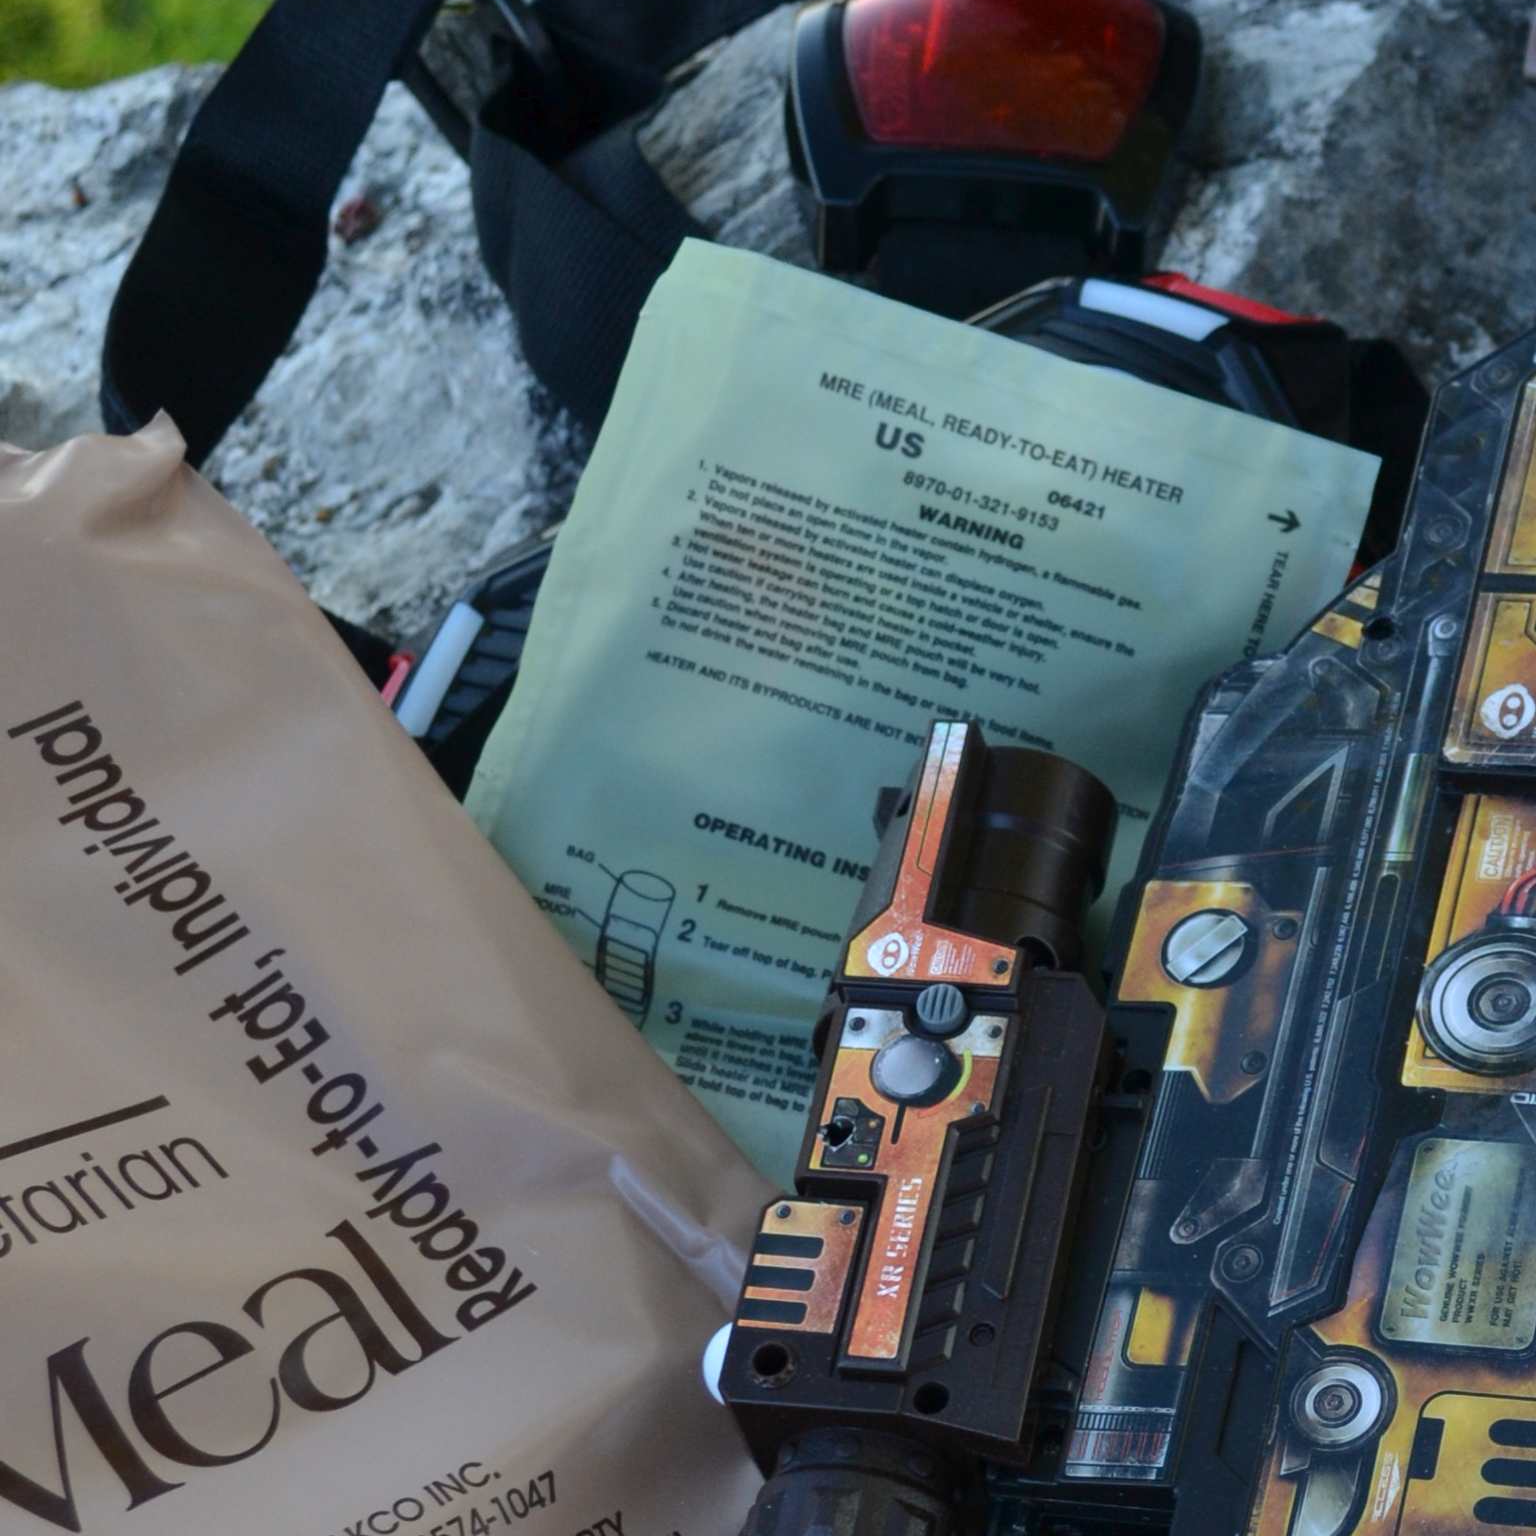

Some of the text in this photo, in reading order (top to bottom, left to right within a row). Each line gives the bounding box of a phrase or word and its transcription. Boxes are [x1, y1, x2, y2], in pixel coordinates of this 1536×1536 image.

[819, 372, 1184, 505] MRE (MEAL, READY-TO-EAT) HEATER
[874, 422, 925, 459] US
[714, 463, 758, 488] Vapors
[759, 481, 813, 506] released
[814, 497, 831, 513] by
[832, 505, 887, 530] activated
[889, 521, 928, 541] heater
[930, 536, 975, 557] contain
[919, 504, 1025, 551] WARNING
[645, 650, 902, 740] HEATER AND ITS BYPRODUCTS ARE NOT
[6, 699, 250, 978] Individual
[565, 844, 596, 864] BAG
[692, 811, 828, 869] OPERATING
[692, 881, 710, 905] 1
[716, 898, 768, 923] Remove
[676, 918, 697, 943] 2
[663, 1000, 684, 1026] 3
[209, 946, 538, 1333] Ready-to-Eat,
[876, 1177, 923, 1299] XR SERIES
[1450, 1275, 1469, 1325] PRODUCT
[425, 1461, 502, 1507] INC.
